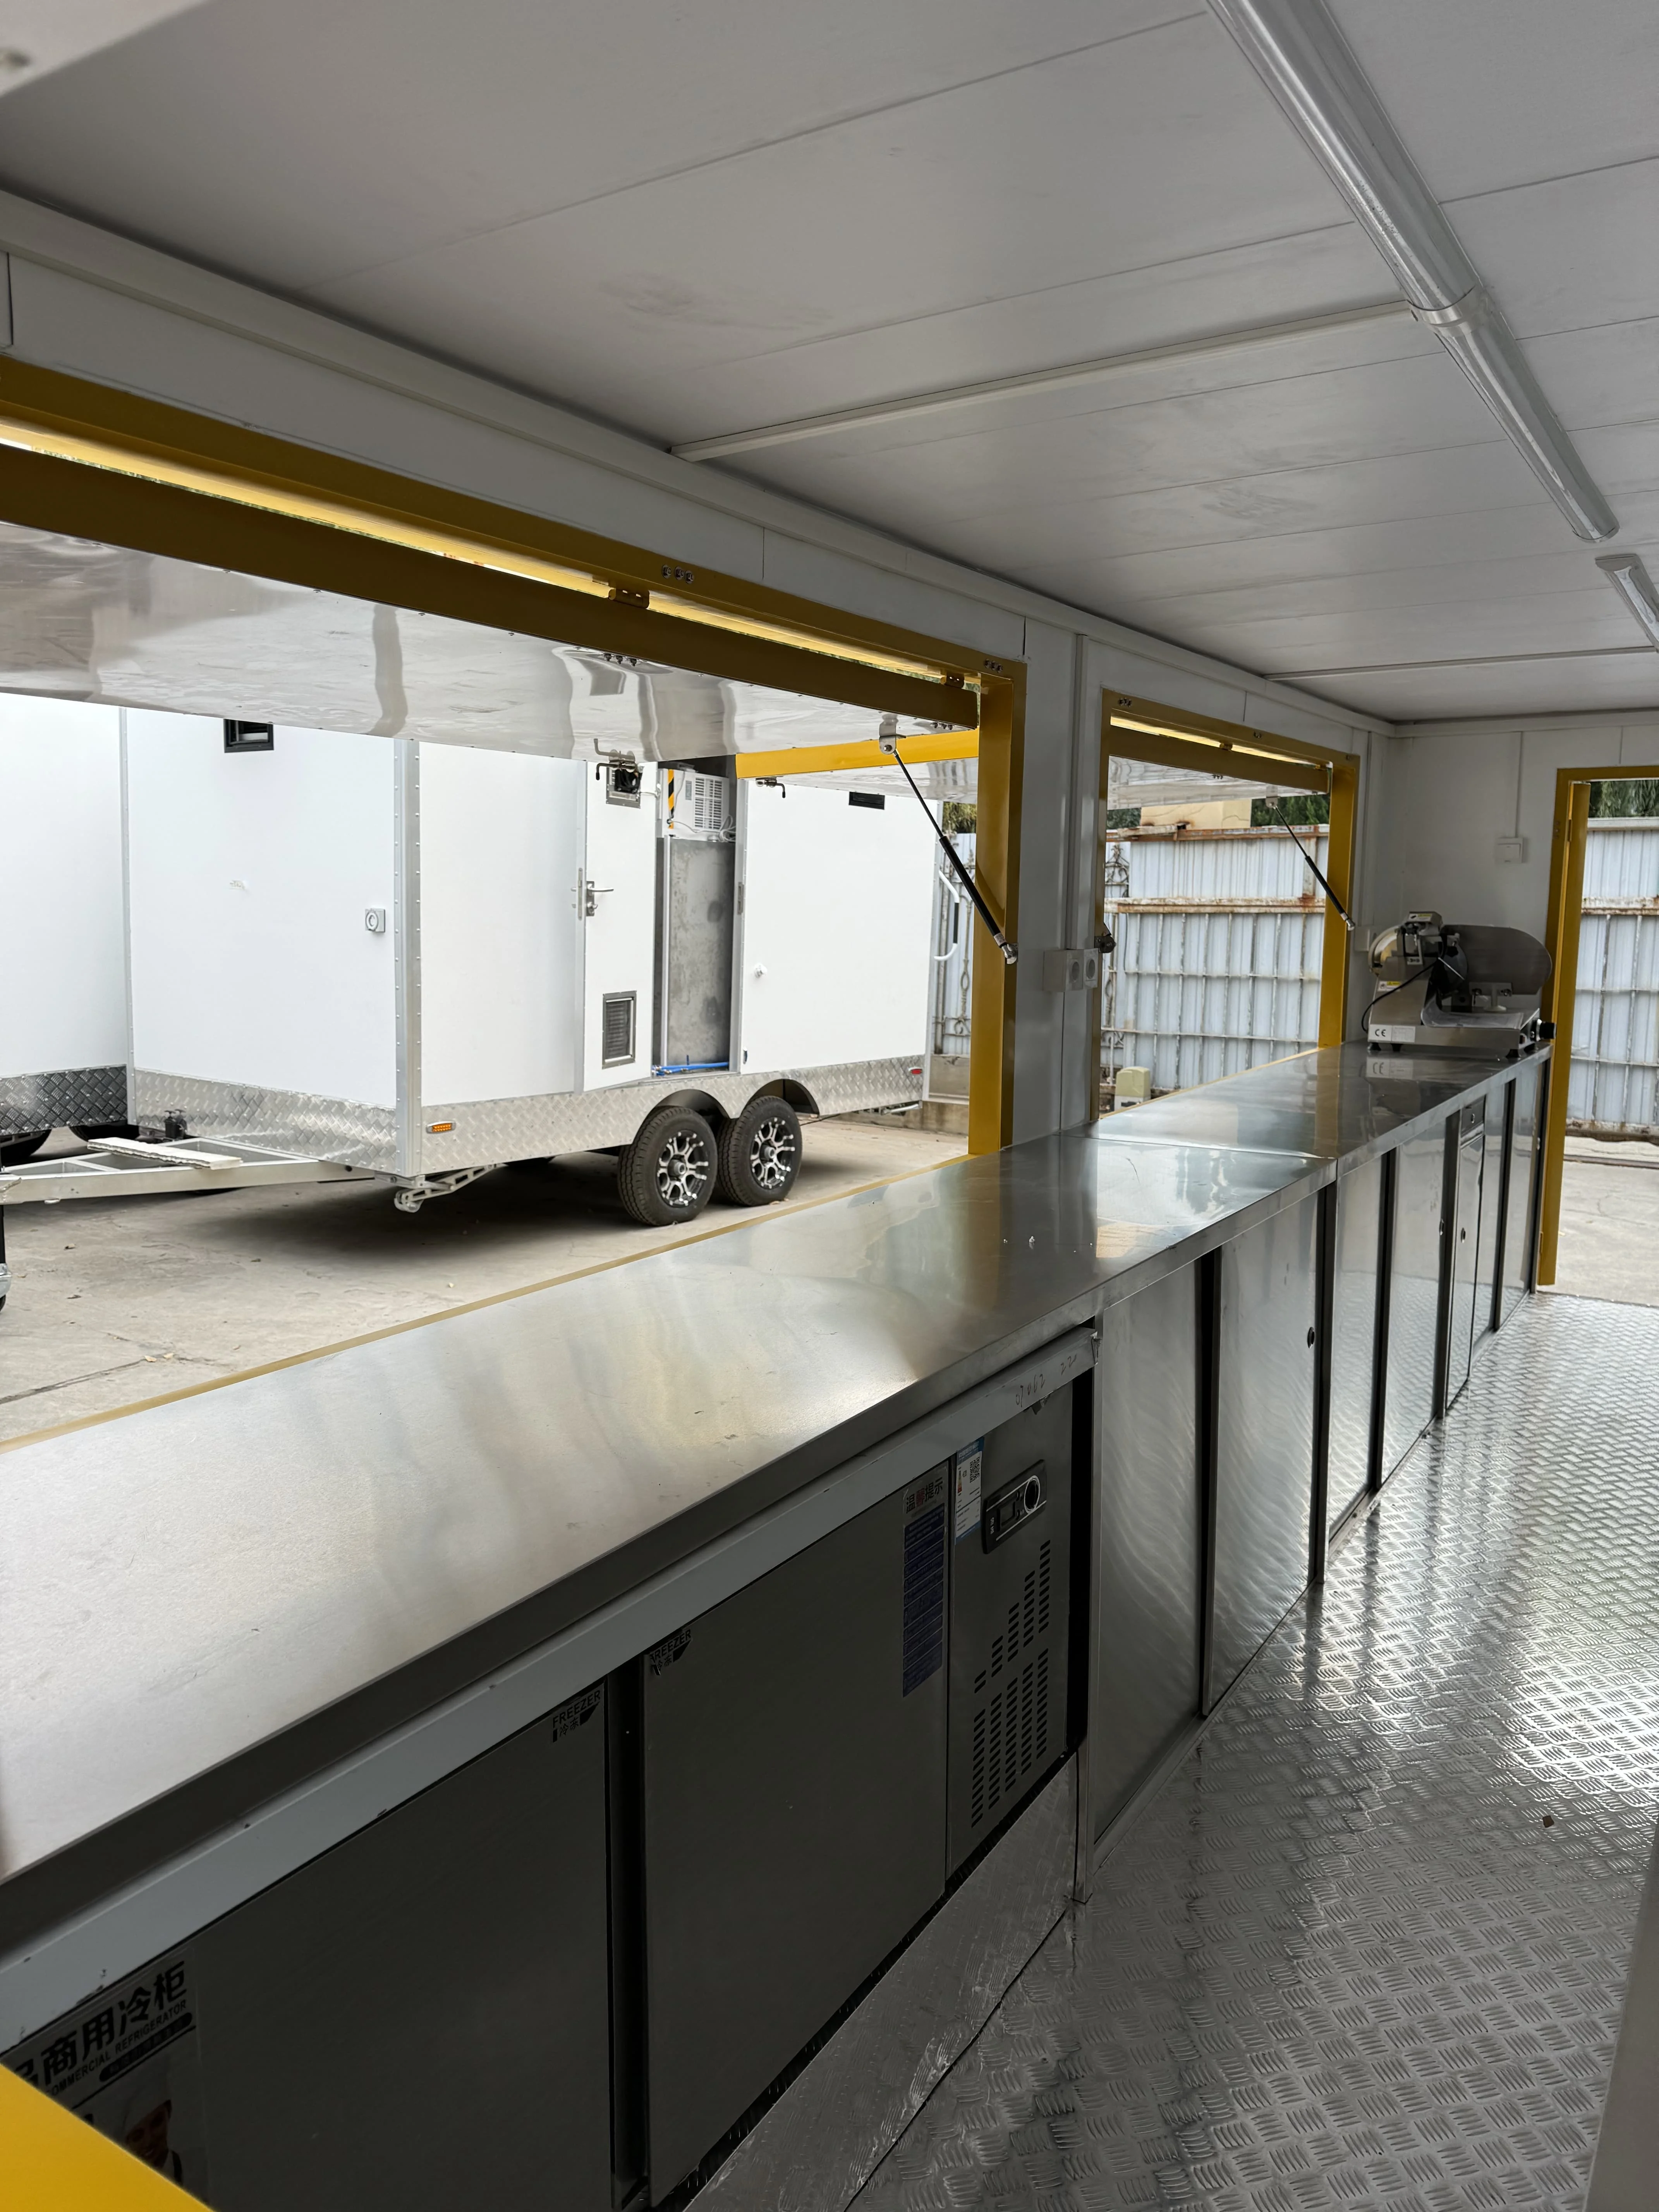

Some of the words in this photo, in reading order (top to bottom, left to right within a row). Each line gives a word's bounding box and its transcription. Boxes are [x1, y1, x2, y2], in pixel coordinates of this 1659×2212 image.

[1375, 1029, 1386, 1037] CE
[906, 1477, 943, 1514] 温馨提示
[553, 1690, 600, 1728] FREEZER
[560, 1717, 578, 1737] 冷冻
[47, 2052, 110, 2096] OMMERCIAL
[115, 1999, 186, 2055] REFRIGERATOR
